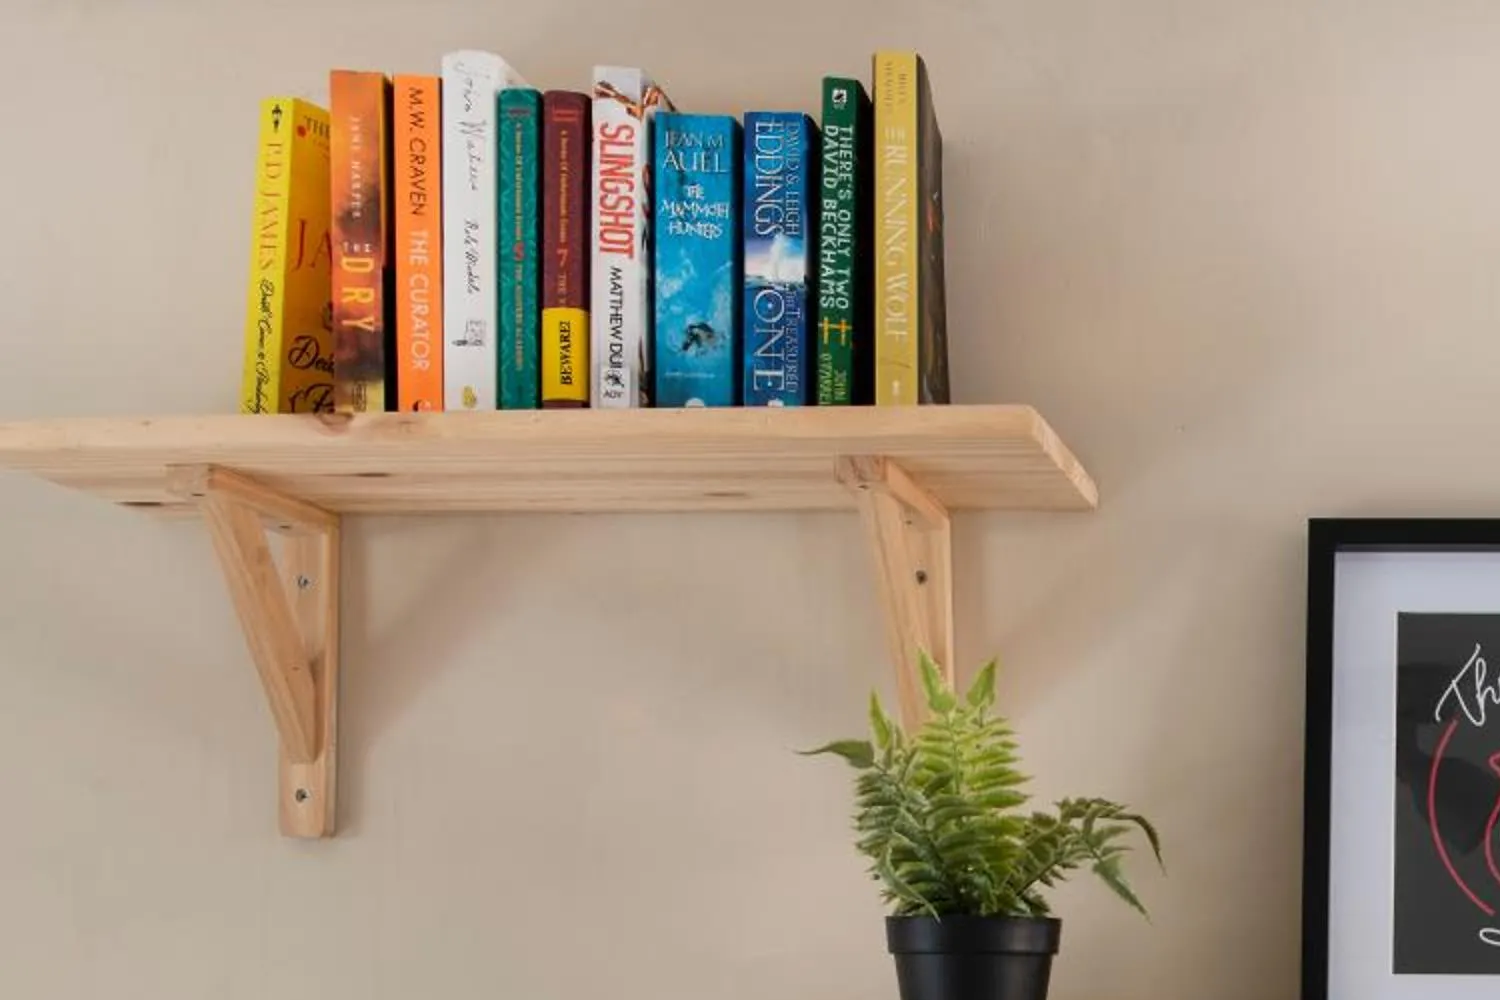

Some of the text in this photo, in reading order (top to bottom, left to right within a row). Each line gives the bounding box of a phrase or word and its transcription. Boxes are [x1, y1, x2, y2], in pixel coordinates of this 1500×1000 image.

[408, 86, 427, 216] M.W. CRAVEN
[661, 149, 731, 173] AUEL
[665, 130, 704, 149] JEAN
[754, 120, 785, 236] EDDINGS
[786, 121, 800, 169] DAVID
[599, 121, 636, 260] SLINGSHOT
[660, 199, 730, 219] MAMMOTH
[667, 220, 724, 240] HUNTERS
[786, 190, 800, 236] LEIGH
[819, 124, 839, 309] DAVID BECKHAMS
[835, 124, 854, 311] THERE'S ONLY TWO
[883, 144, 908, 267] RUNNING
[257, 190, 281, 271] JAMES
[340, 256, 375, 333] DRY
[410, 231, 430, 372] THE CURATOR
[608, 265, 625, 342] MATTHEW
[885, 273, 908, 343] WOLF
[753, 289, 786, 392] ONE
